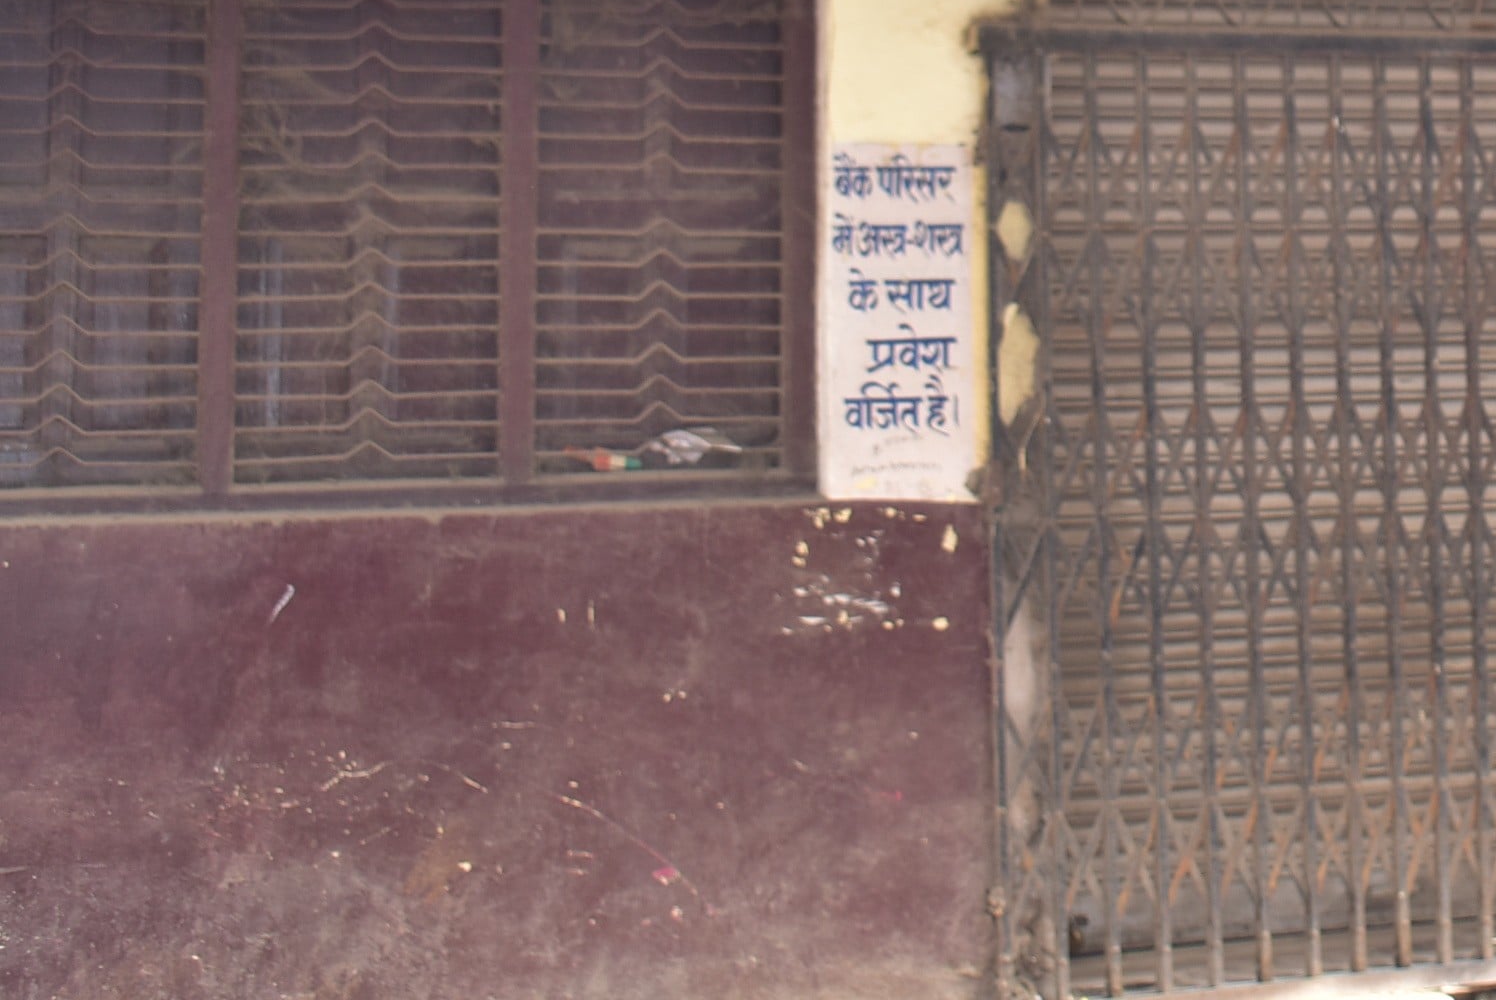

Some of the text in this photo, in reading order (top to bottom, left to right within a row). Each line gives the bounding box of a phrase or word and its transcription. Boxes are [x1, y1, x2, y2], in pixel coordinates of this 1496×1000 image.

[876, 154, 957, 203] परिसर
[848, 266, 956, 314] के साथ
[866, 323, 958, 374] प्रवेश
